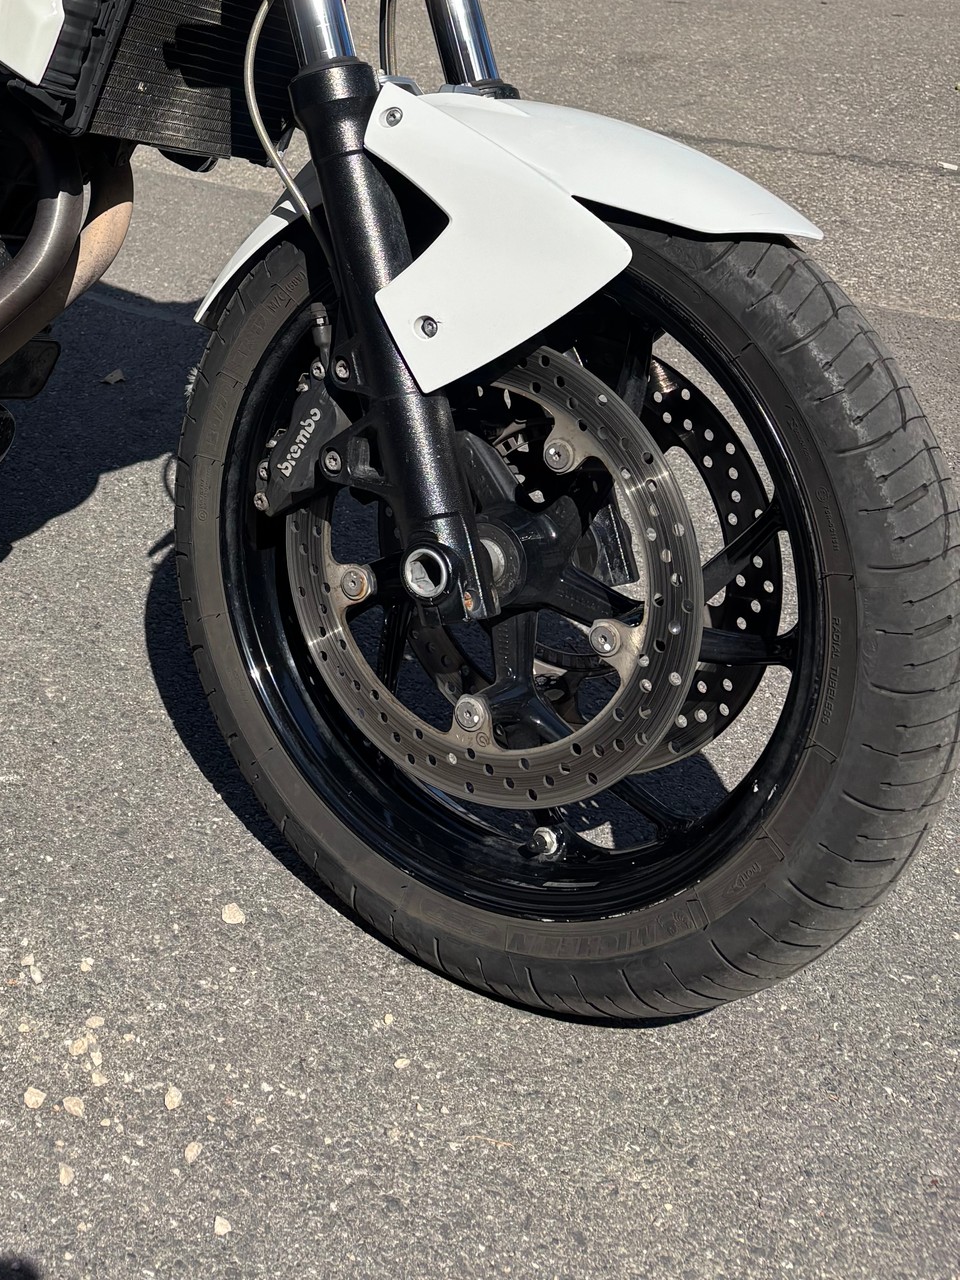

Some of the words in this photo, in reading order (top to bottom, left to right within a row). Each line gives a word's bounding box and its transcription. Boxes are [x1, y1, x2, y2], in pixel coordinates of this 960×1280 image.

[277, 408, 321, 477] brembo
[831, 616, 842, 659] RADIAL
[821, 666, 840, 726] TUBELESS
